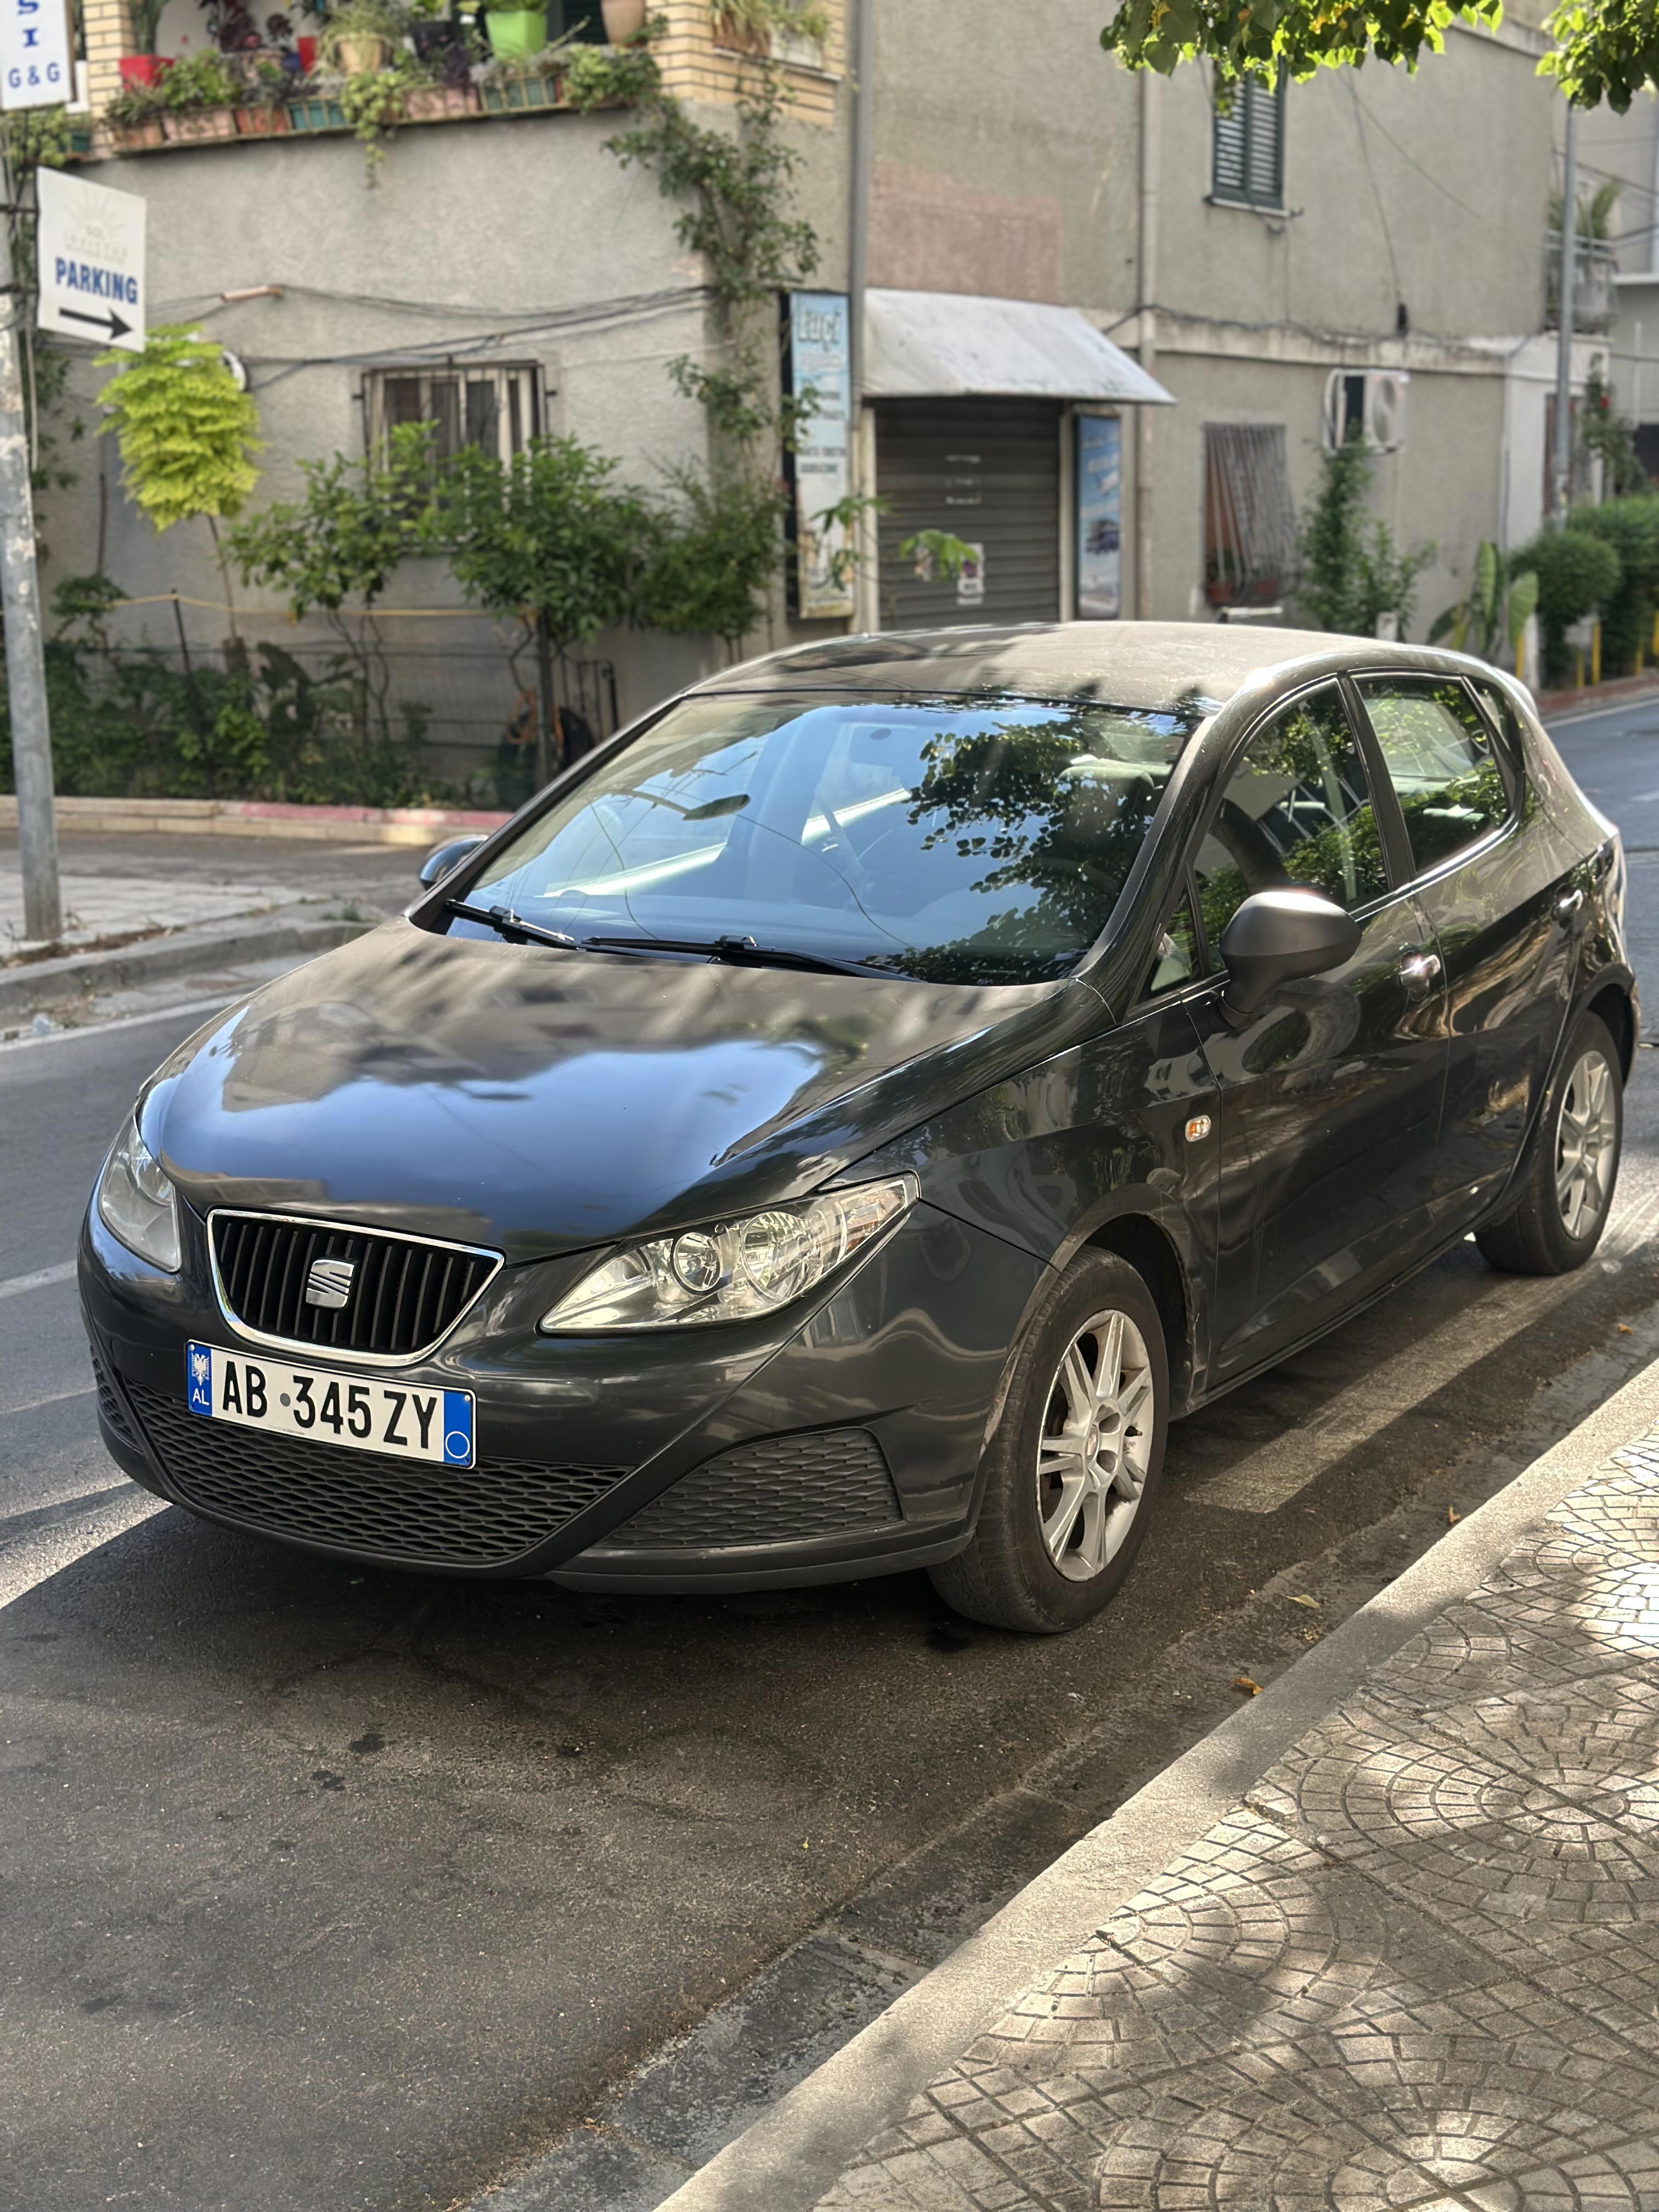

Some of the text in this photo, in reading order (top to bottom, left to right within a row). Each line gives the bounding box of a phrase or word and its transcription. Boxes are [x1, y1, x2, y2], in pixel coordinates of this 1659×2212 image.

[55, 256, 138, 304] PARKING
[192, 1387, 210, 1406] AL
[222, 1360, 268, 1418] AB
